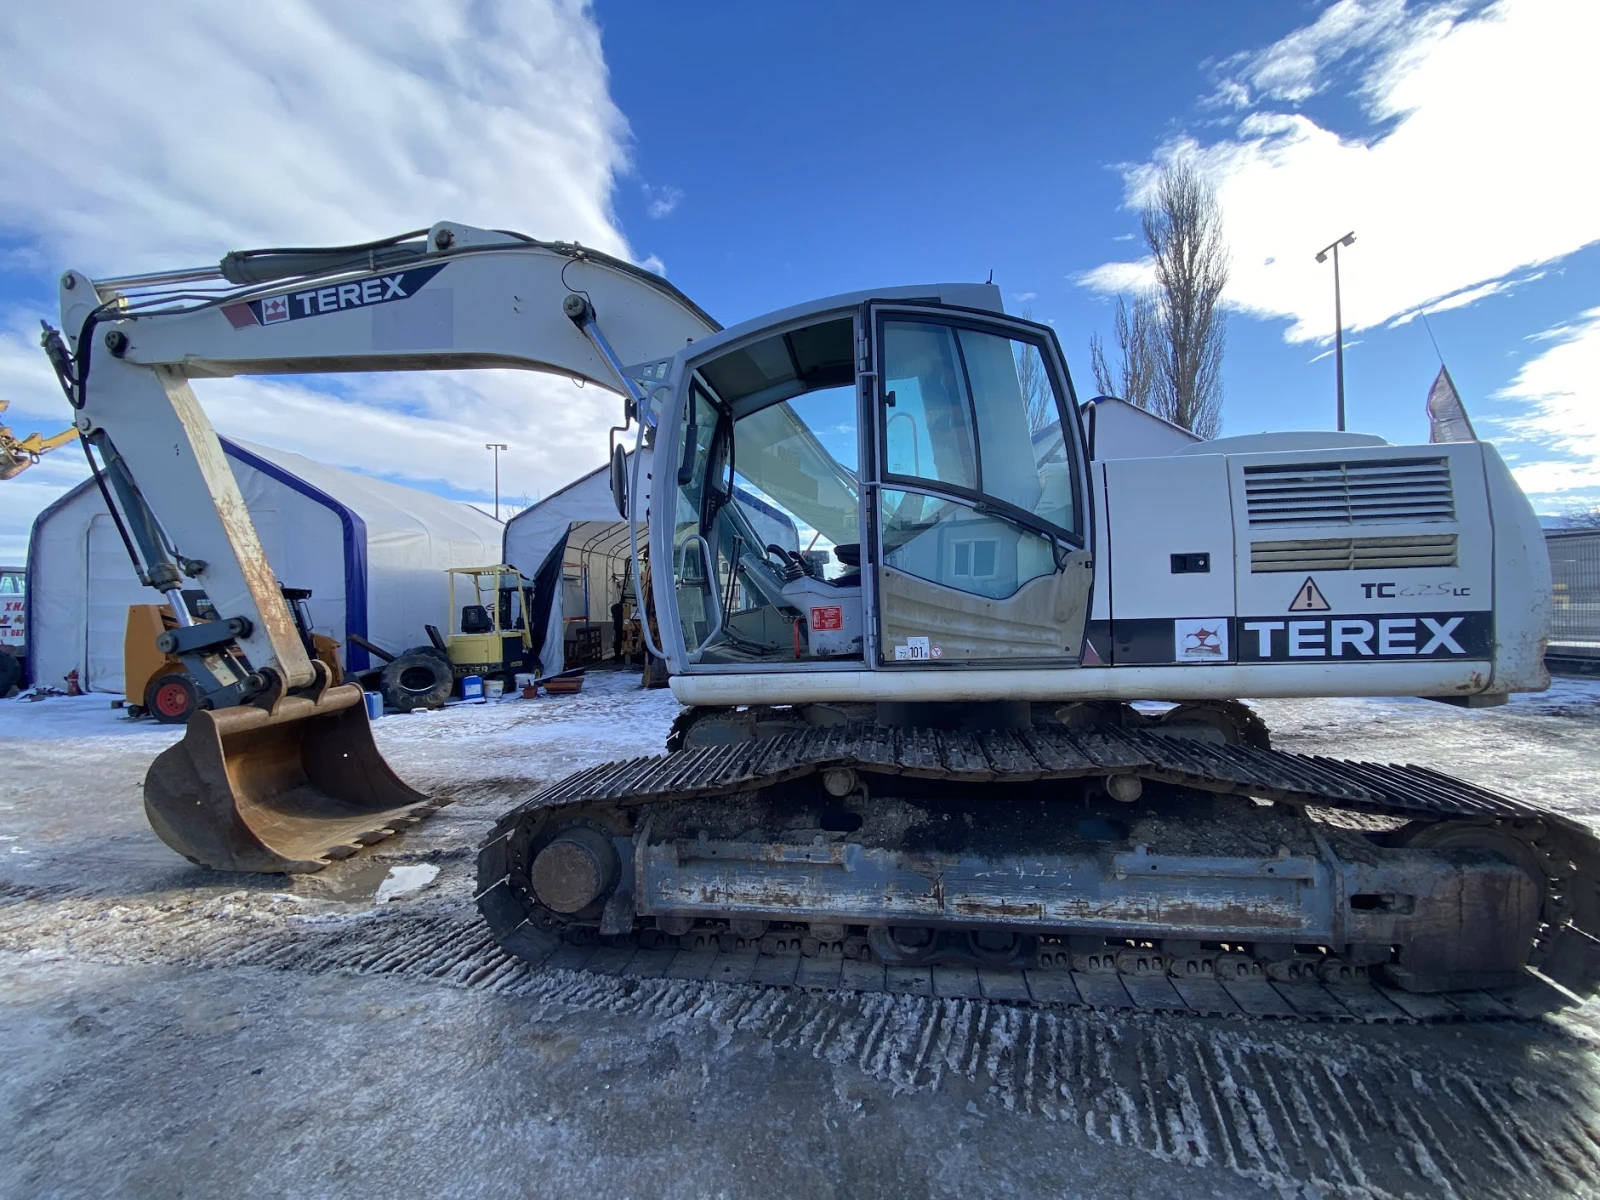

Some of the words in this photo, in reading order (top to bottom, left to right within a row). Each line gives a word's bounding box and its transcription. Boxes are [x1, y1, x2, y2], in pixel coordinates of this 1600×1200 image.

[296, 274, 408, 315] TEREX
[1360, 582, 1396, 599] TC
[1453, 587, 1471, 597] LC
[1244, 616, 1467, 658] TEREX
[909, 646, 923, 659] 101
